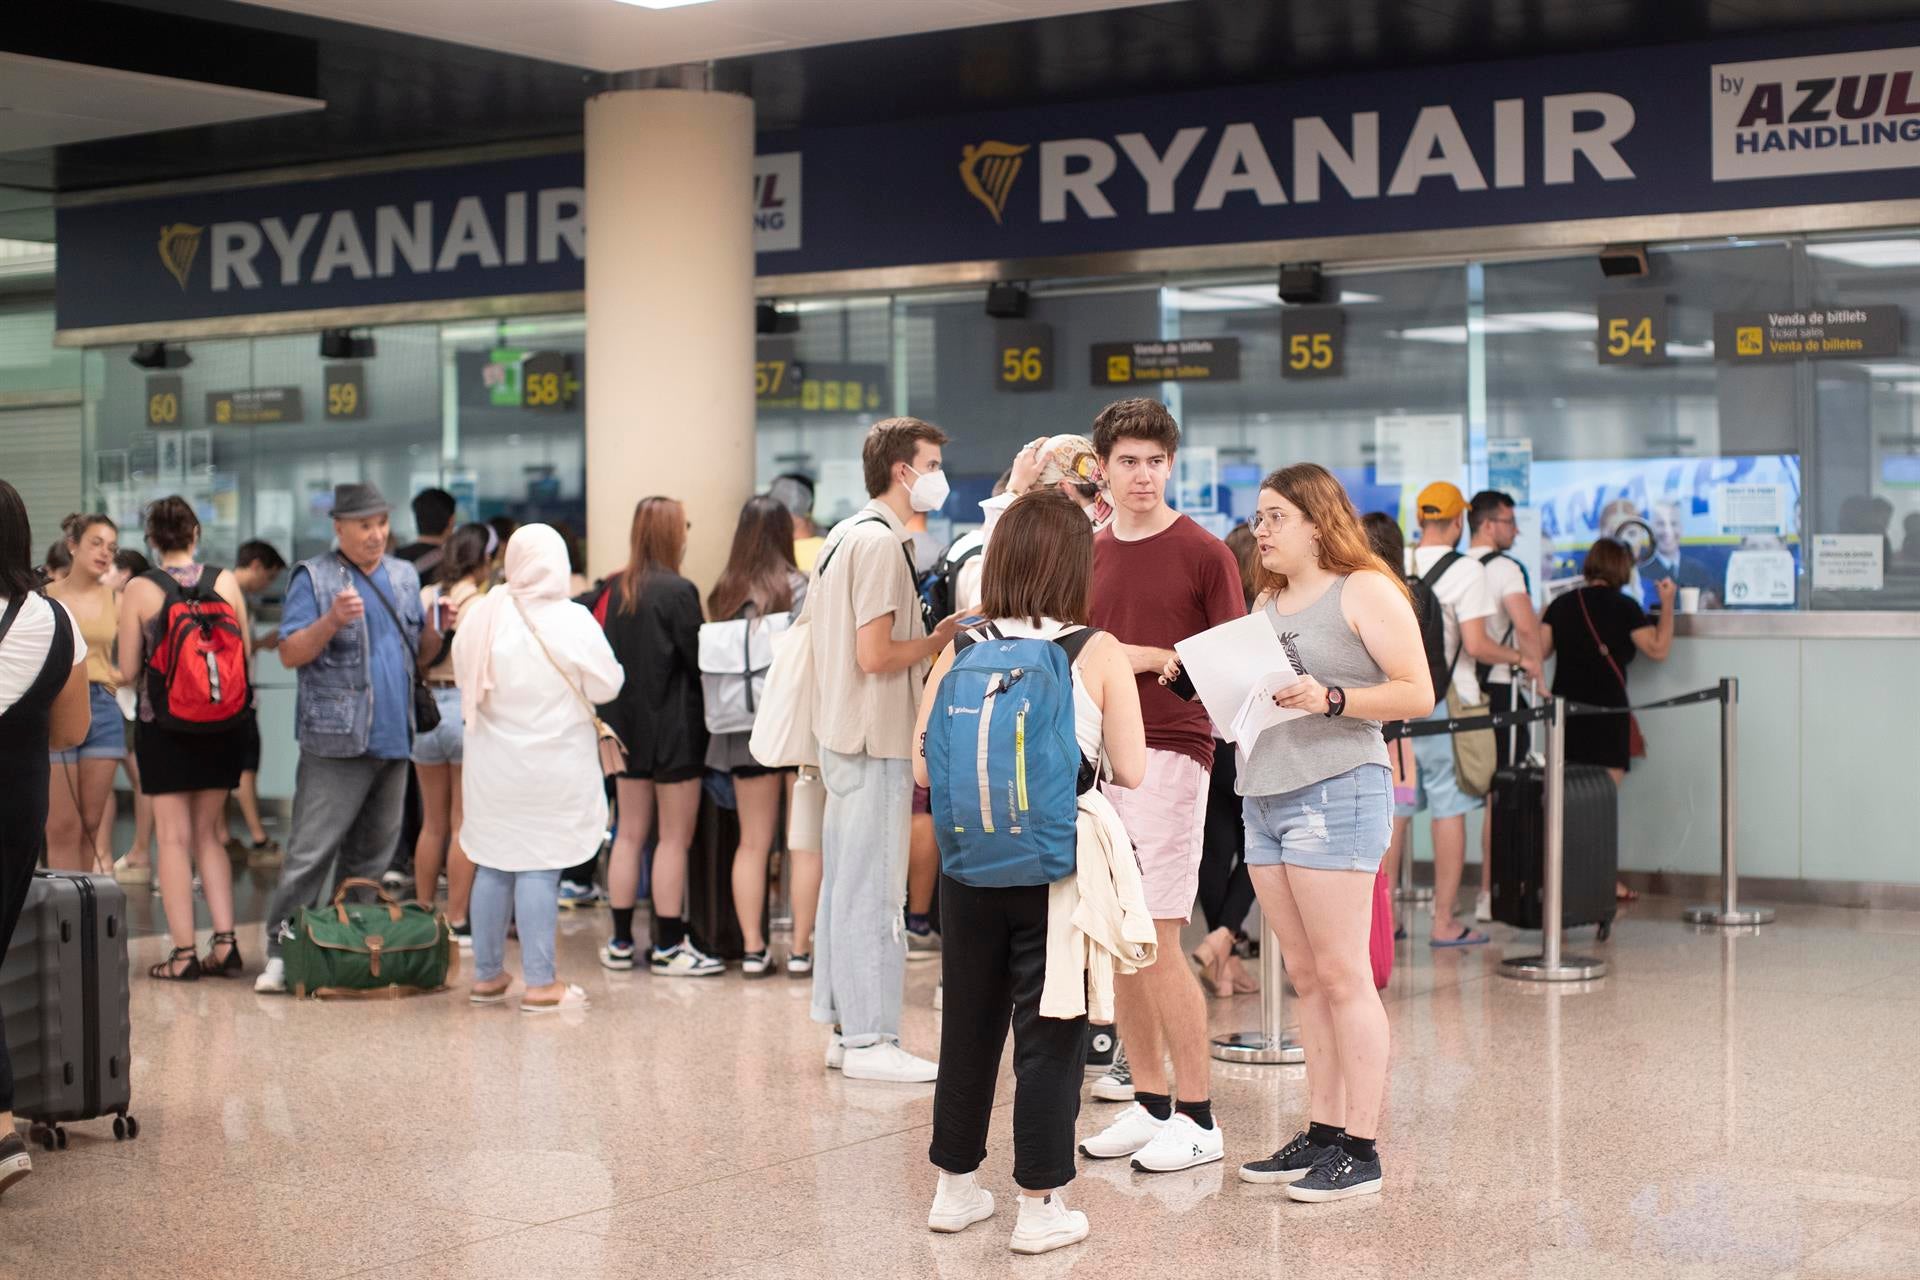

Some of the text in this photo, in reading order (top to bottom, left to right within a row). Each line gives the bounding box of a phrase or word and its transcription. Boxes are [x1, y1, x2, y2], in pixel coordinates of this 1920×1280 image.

[1720, 74, 1744, 96] by
[1737, 70, 1920, 128] AZUL
[1736, 118, 1920, 154] HANDLING
[1039, 91, 1637, 223] RYANAIR
[211, 187, 586, 292] RYANAIR
[1768, 312, 1805, 326] Venda
[1809, 311, 1824, 324] de
[1290, 333, 1333, 370] 55
[1608, 317, 1656, 356] 54
[1770, 338, 1864, 353] Venta de billetes
[755, 361, 785, 396] 57
[1003, 347, 1042, 382] 56
[328, 383, 357, 415] 59
[527, 373, 559, 405] 58
[151, 393, 177, 423] 60
